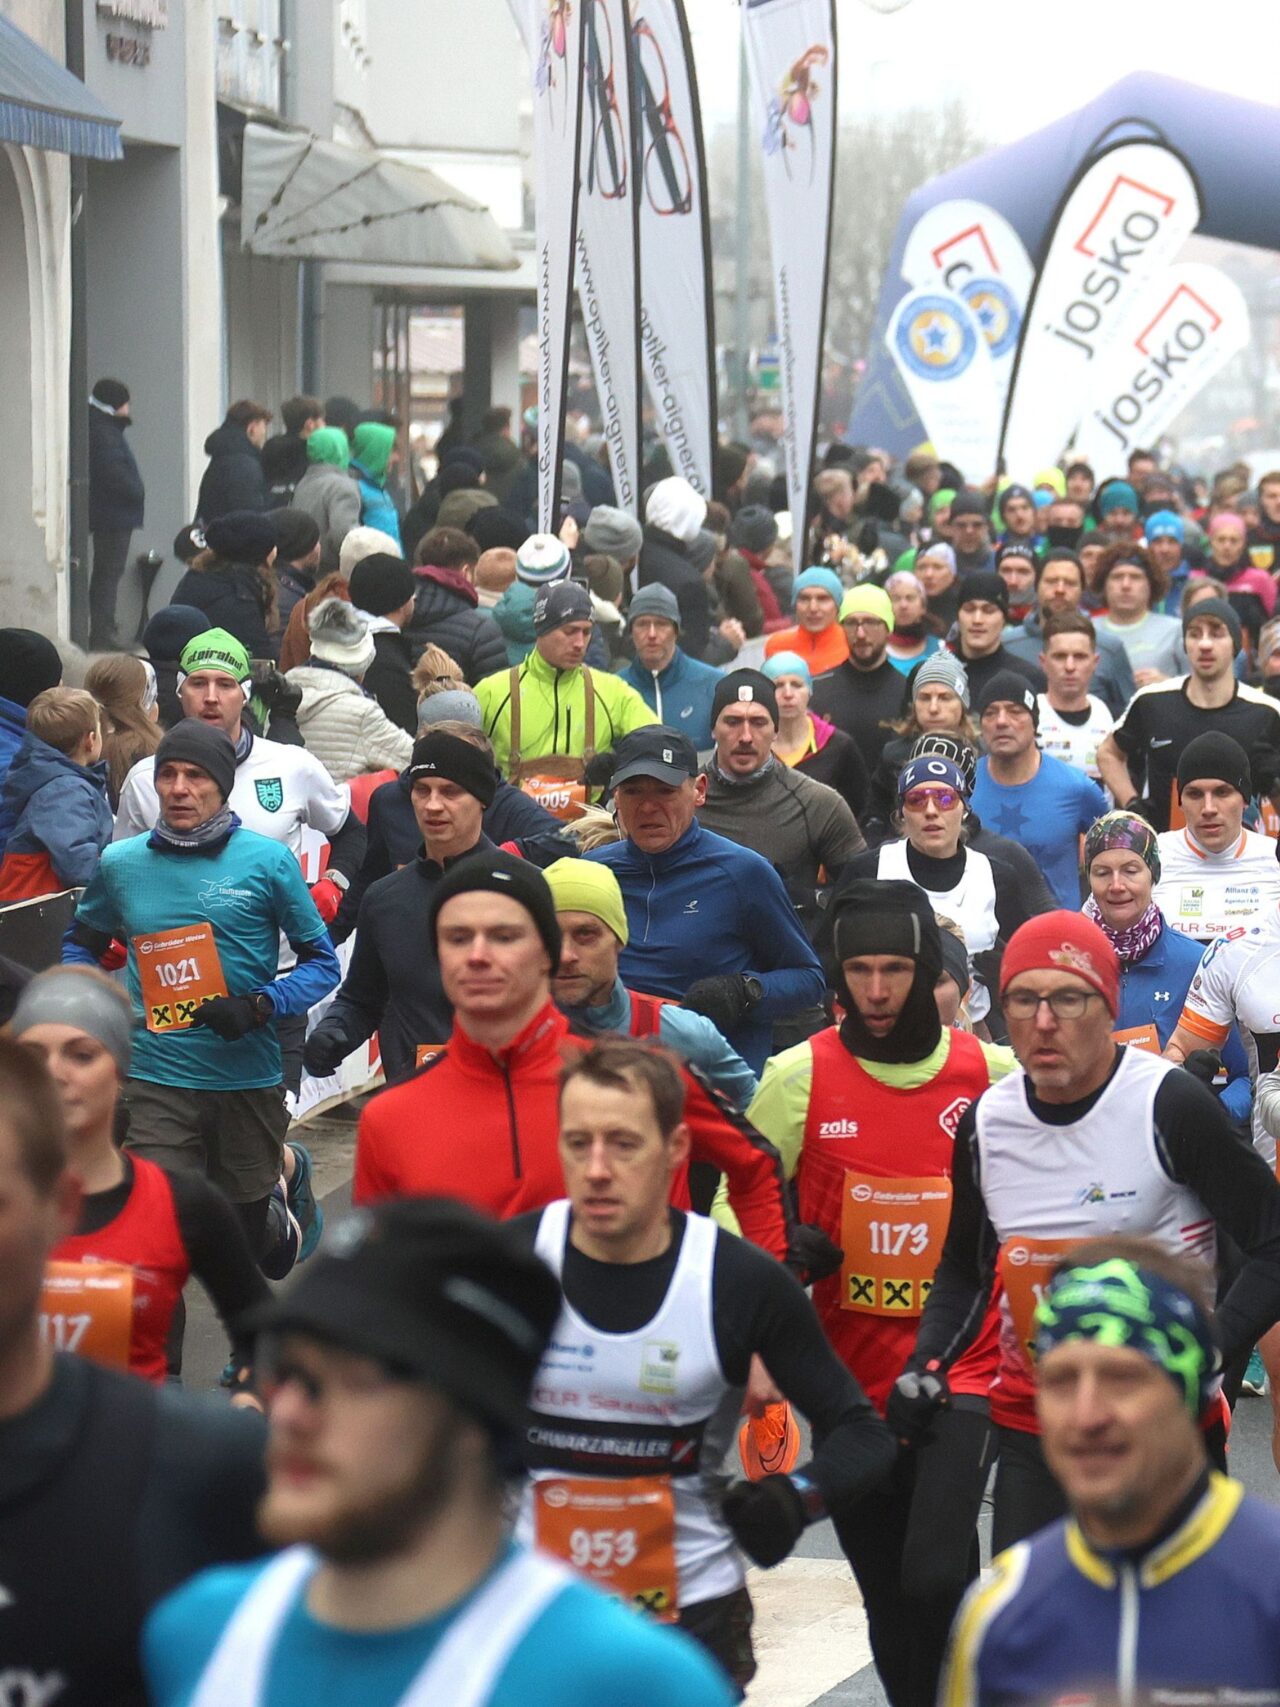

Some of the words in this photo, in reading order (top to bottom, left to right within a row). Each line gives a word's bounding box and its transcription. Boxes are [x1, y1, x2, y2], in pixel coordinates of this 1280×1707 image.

[155, 957, 201, 987] 1021
[869, 1220, 930, 1256] 1173
[569, 1528, 637, 1568] 953
